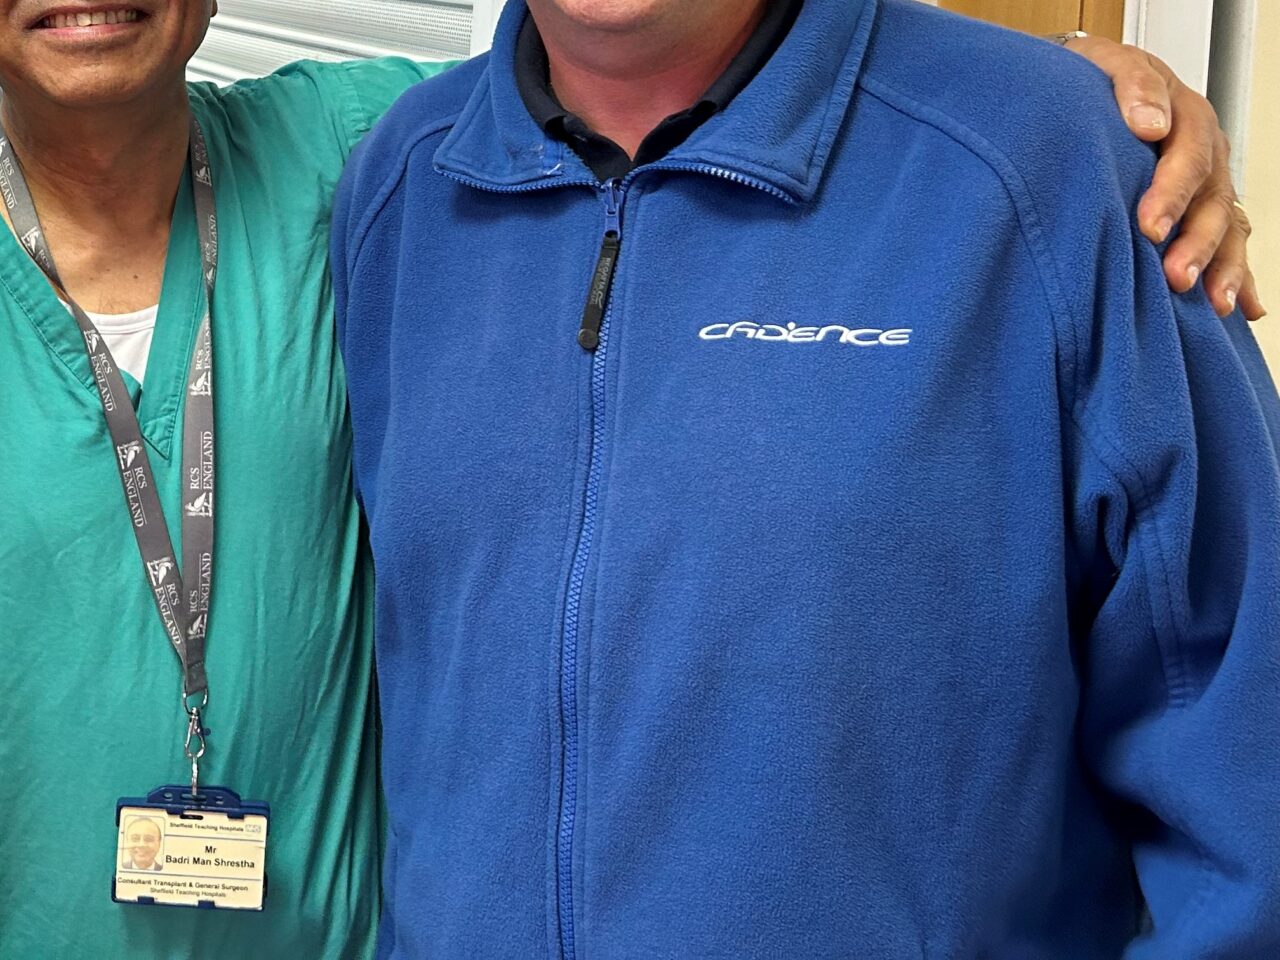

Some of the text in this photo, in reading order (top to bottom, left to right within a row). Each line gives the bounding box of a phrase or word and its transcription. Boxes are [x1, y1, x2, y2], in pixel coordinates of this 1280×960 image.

[3, 157, 14, 176] RCS
[99, 352, 112, 375] RCS
[195, 348, 204, 371] RCS
[91, 356, 114, 412] ENGLAND
[203, 431, 213, 490] ENGLAND
[134, 466, 147, 489] RCS
[190, 467, 200, 490] RCS
[123, 471, 144, 528] ENGLAND
[200, 552, 212, 612] ENGLAND
[167, 583, 180, 606] RCS
[190, 590, 199, 613] RCS
[155, 586, 182, 644] ENGLAND
[195, 823, 218, 832] Teaching
[205, 845, 217, 854] Mr
[165, 854, 255, 869] Badri Man Shrestha
[117, 876, 152, 885] Consultant
[154, 879, 187, 888] Transplant
[221, 883, 249, 892] Surgeon
[150, 887, 174, 895] Sheffield
[176, 889, 200, 897] Teaching
